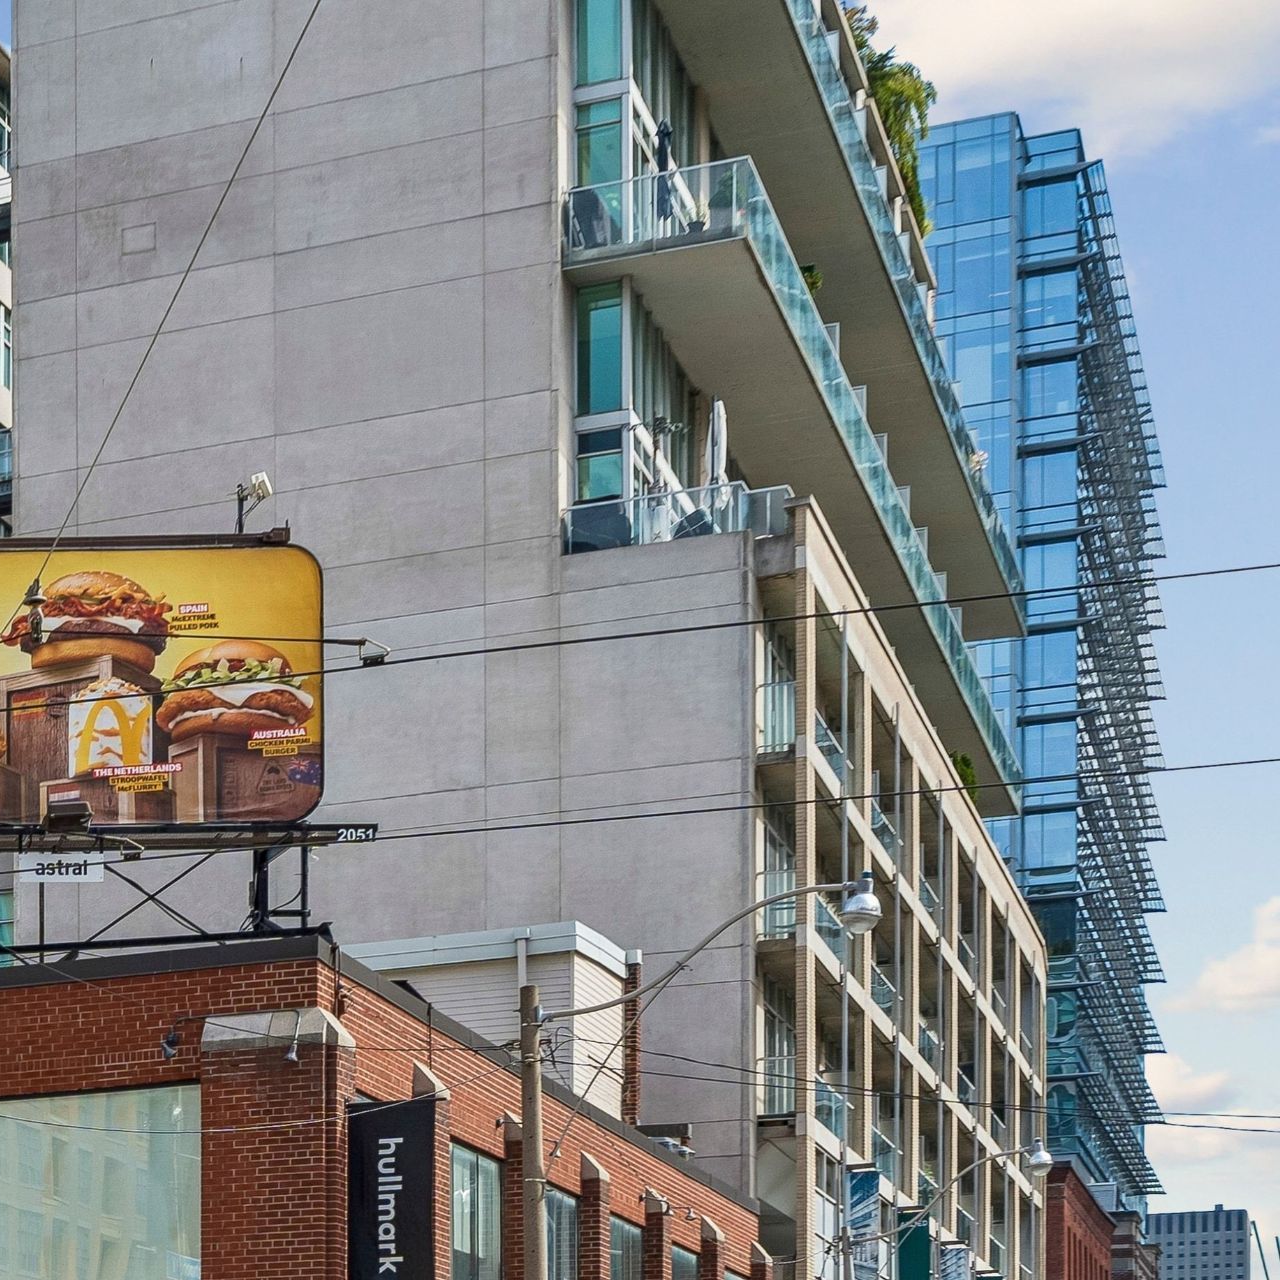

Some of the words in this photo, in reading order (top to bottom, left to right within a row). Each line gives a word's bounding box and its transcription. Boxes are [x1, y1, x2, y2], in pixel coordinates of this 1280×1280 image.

[179, 604, 208, 614] SPAIN
[252, 727, 306, 739] AUSTRALIA
[249, 739, 285, 748] CHICKEN
[264, 747, 296, 755] BURGER
[93, 768, 113, 777] THE
[114, 763, 182, 776] NETHERLANDS
[337, 828, 375, 842] 2051
[35, 859, 87, 876] astral
[378, 1136, 404, 1274] hullmark
